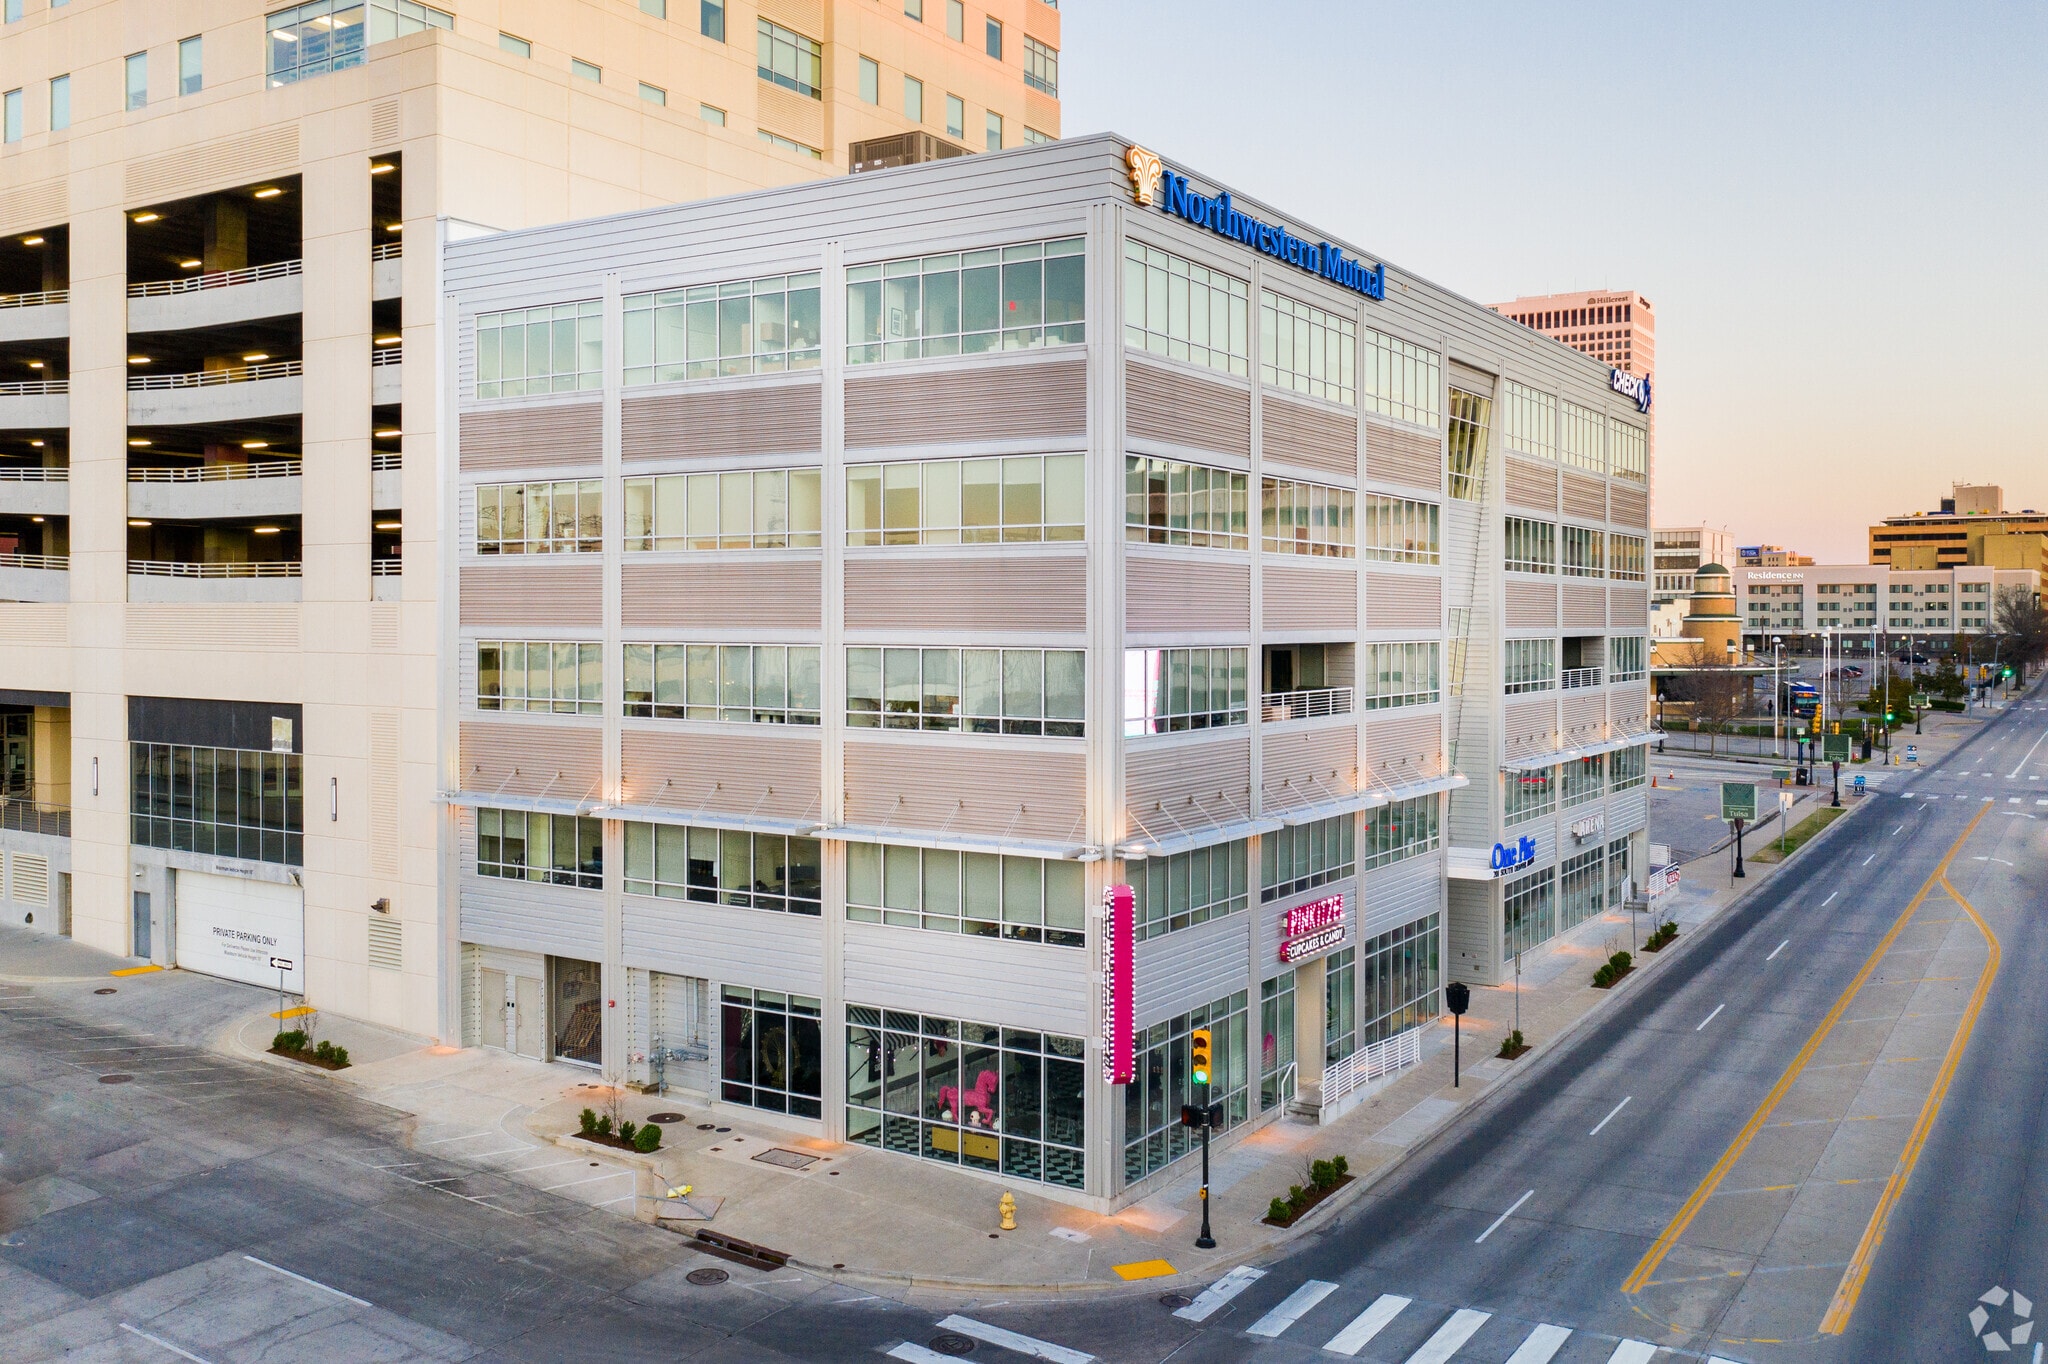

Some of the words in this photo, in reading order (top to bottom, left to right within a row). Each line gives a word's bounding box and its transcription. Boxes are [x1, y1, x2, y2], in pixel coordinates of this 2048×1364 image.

[1162, 169, 1320, 273] Northwestern
[1319, 241, 1386, 300] Mutual
[1597, 296, 1629, 304] Hillcrest
[1612, 369, 1640, 399] CHECK
[1747, 571, 1792, 580] Residence
[1729, 810, 1749, 818] Tulsa
[1491, 842, 1517, 870] One
[1289, 895, 1346, 937] PINKITZEL
[212, 926, 236, 939] PRIVATE
[236, 930, 261, 944] PARKING
[261, 935, 278, 947] ONLY
[1289, 938, 1320, 958] CUPCAKES
[1324, 928, 1344, 943] CANDY
